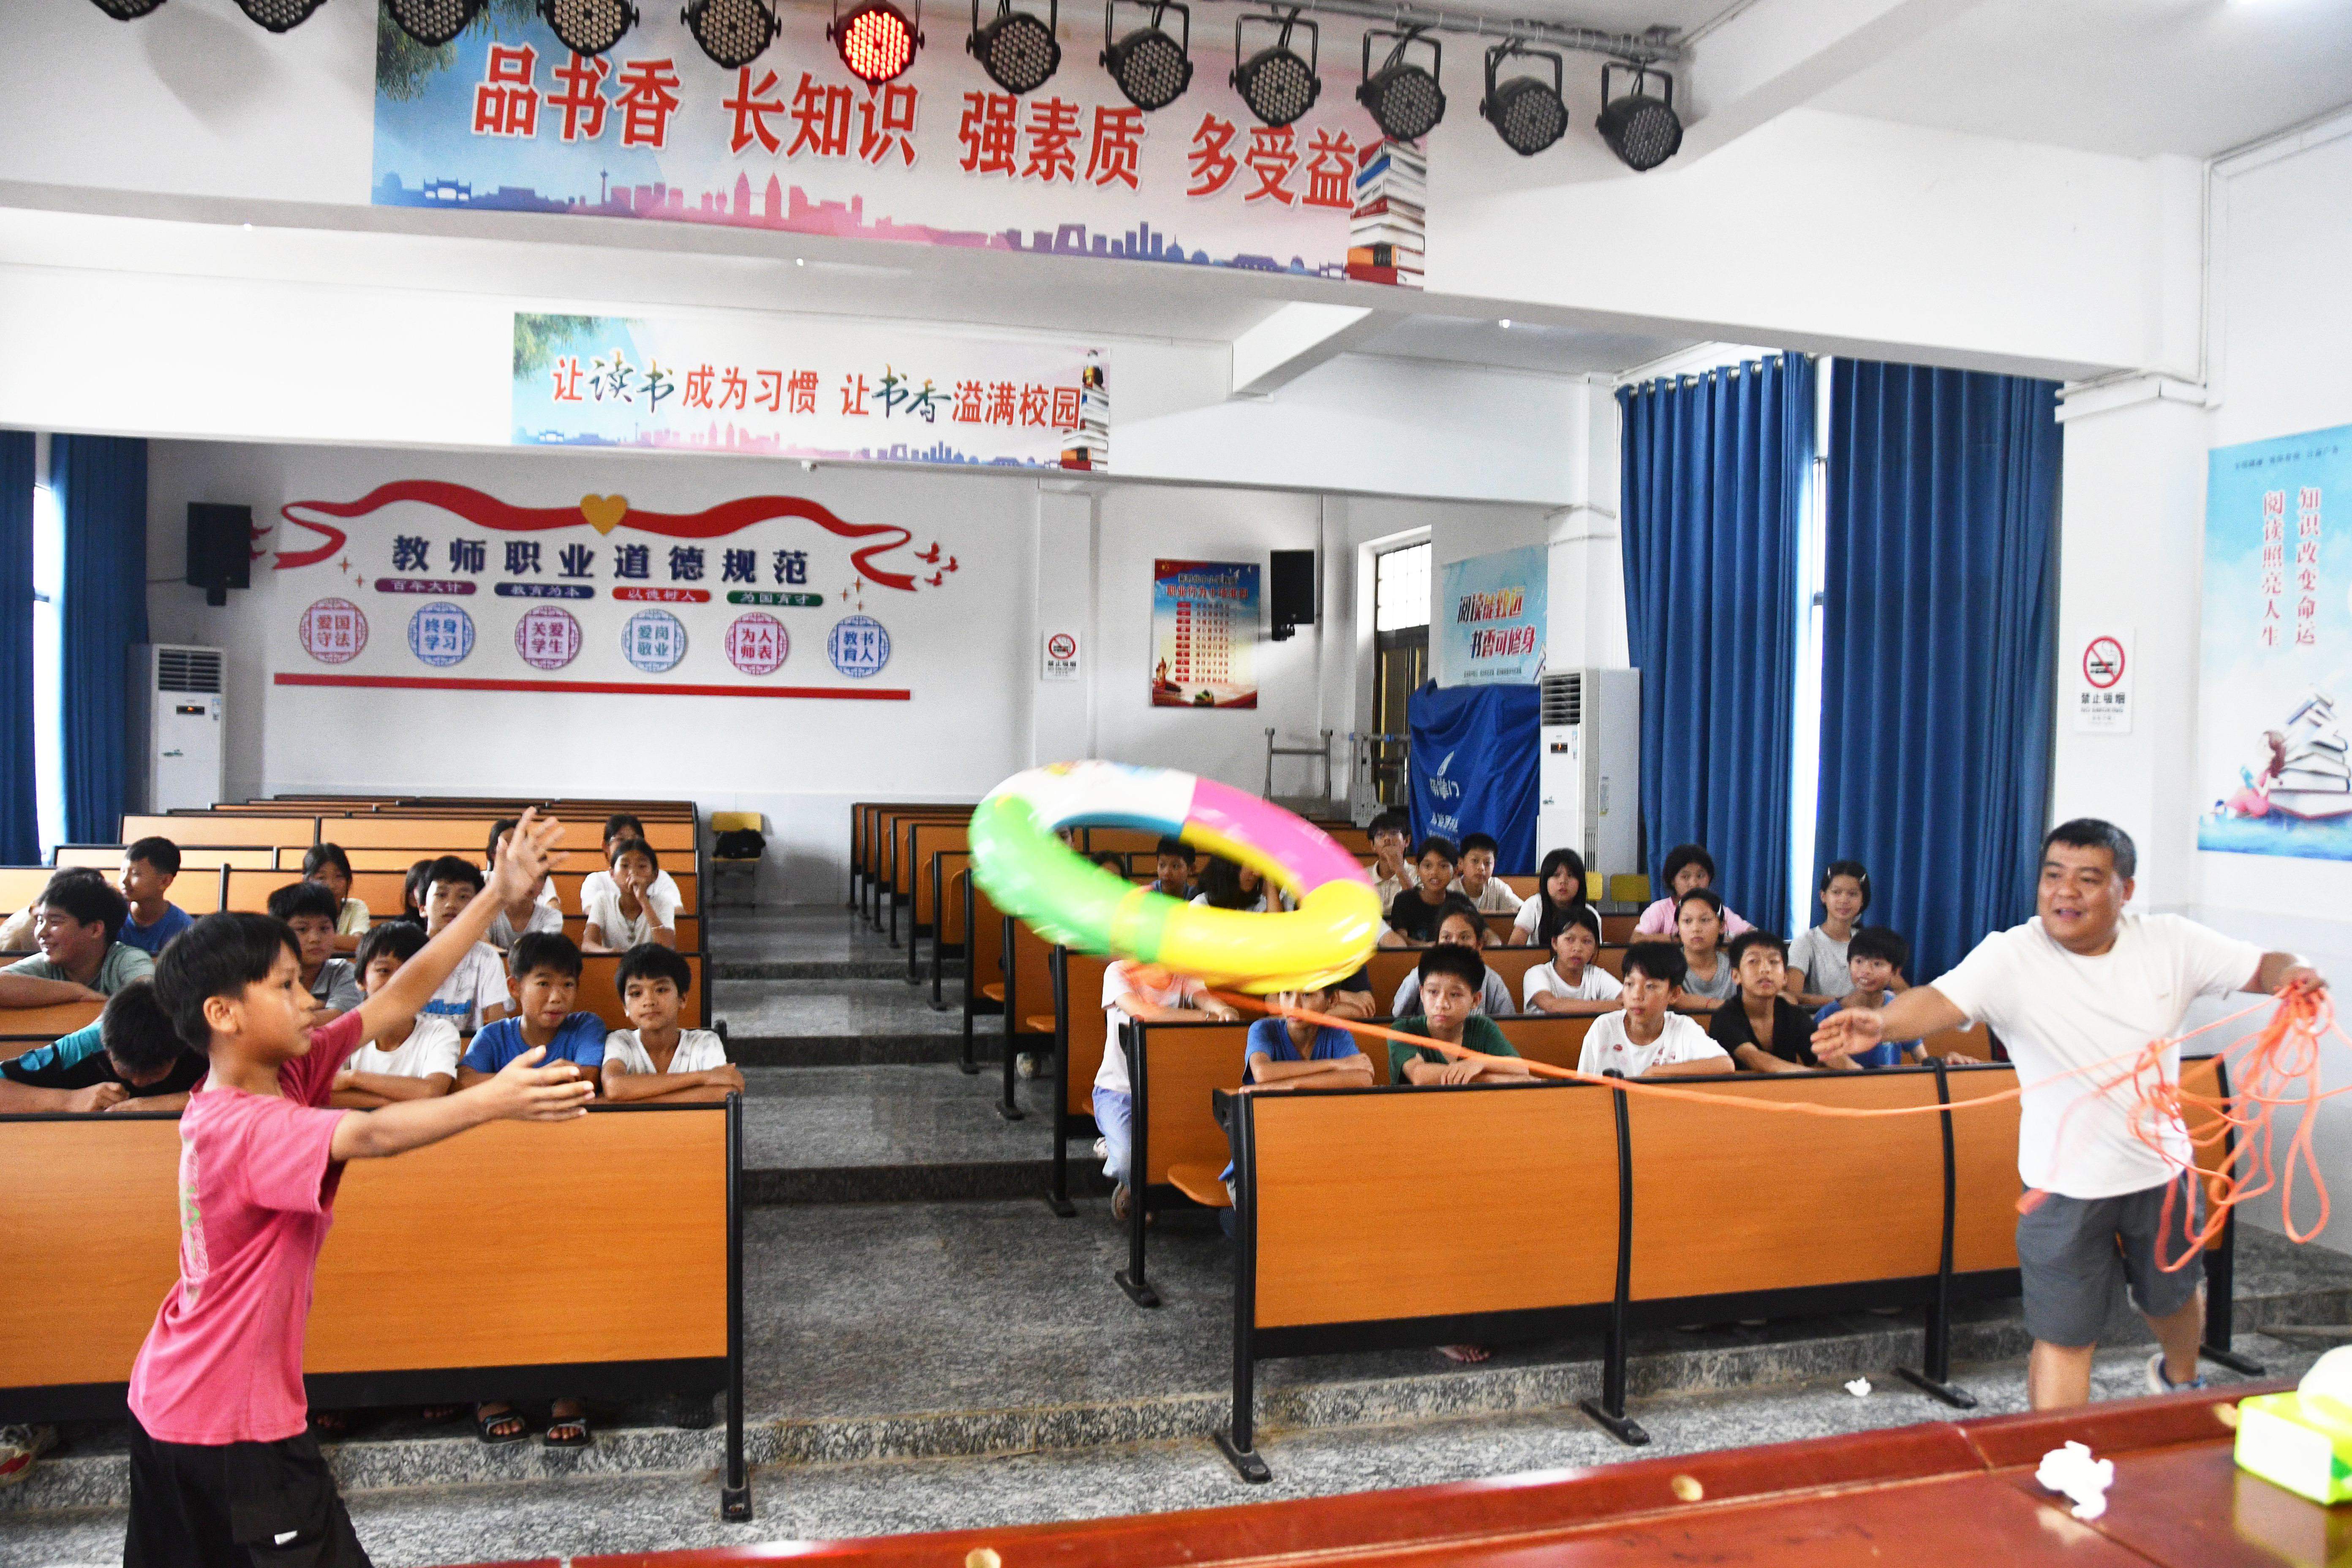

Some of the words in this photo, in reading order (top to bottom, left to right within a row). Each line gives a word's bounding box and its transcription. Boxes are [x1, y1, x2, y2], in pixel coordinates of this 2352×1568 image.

[475, 47, 680, 147] 品书香
[723, 67, 918, 166] 长知识
[959, 91, 1145, 190] 强素质
[1187, 114, 1355, 209] 多受益
[552, 350, 819, 414] 让读书成为习惯
[841, 364, 1080, 430] 让书香溢满校园
[392, 535, 808, 585] 教师职业道德规范
[2296, 487, 2319, 645] 知识改变命运
[511, 585, 579, 596] 教育为本
[532, 621, 564, 636] 关爱
[638, 624, 669, 640] 爱岗
[741, 627, 773, 643] 为人
[424, 634, 457, 652] 学习
[531, 637, 564, 655] 学生
[843, 630, 874, 646] 教书
[1470, 625, 1536, 659] 书香可修身
[637, 641, 669, 657] 敬业
[741, 643, 773, 660] 师表
[844, 647, 874, 664] 育人
